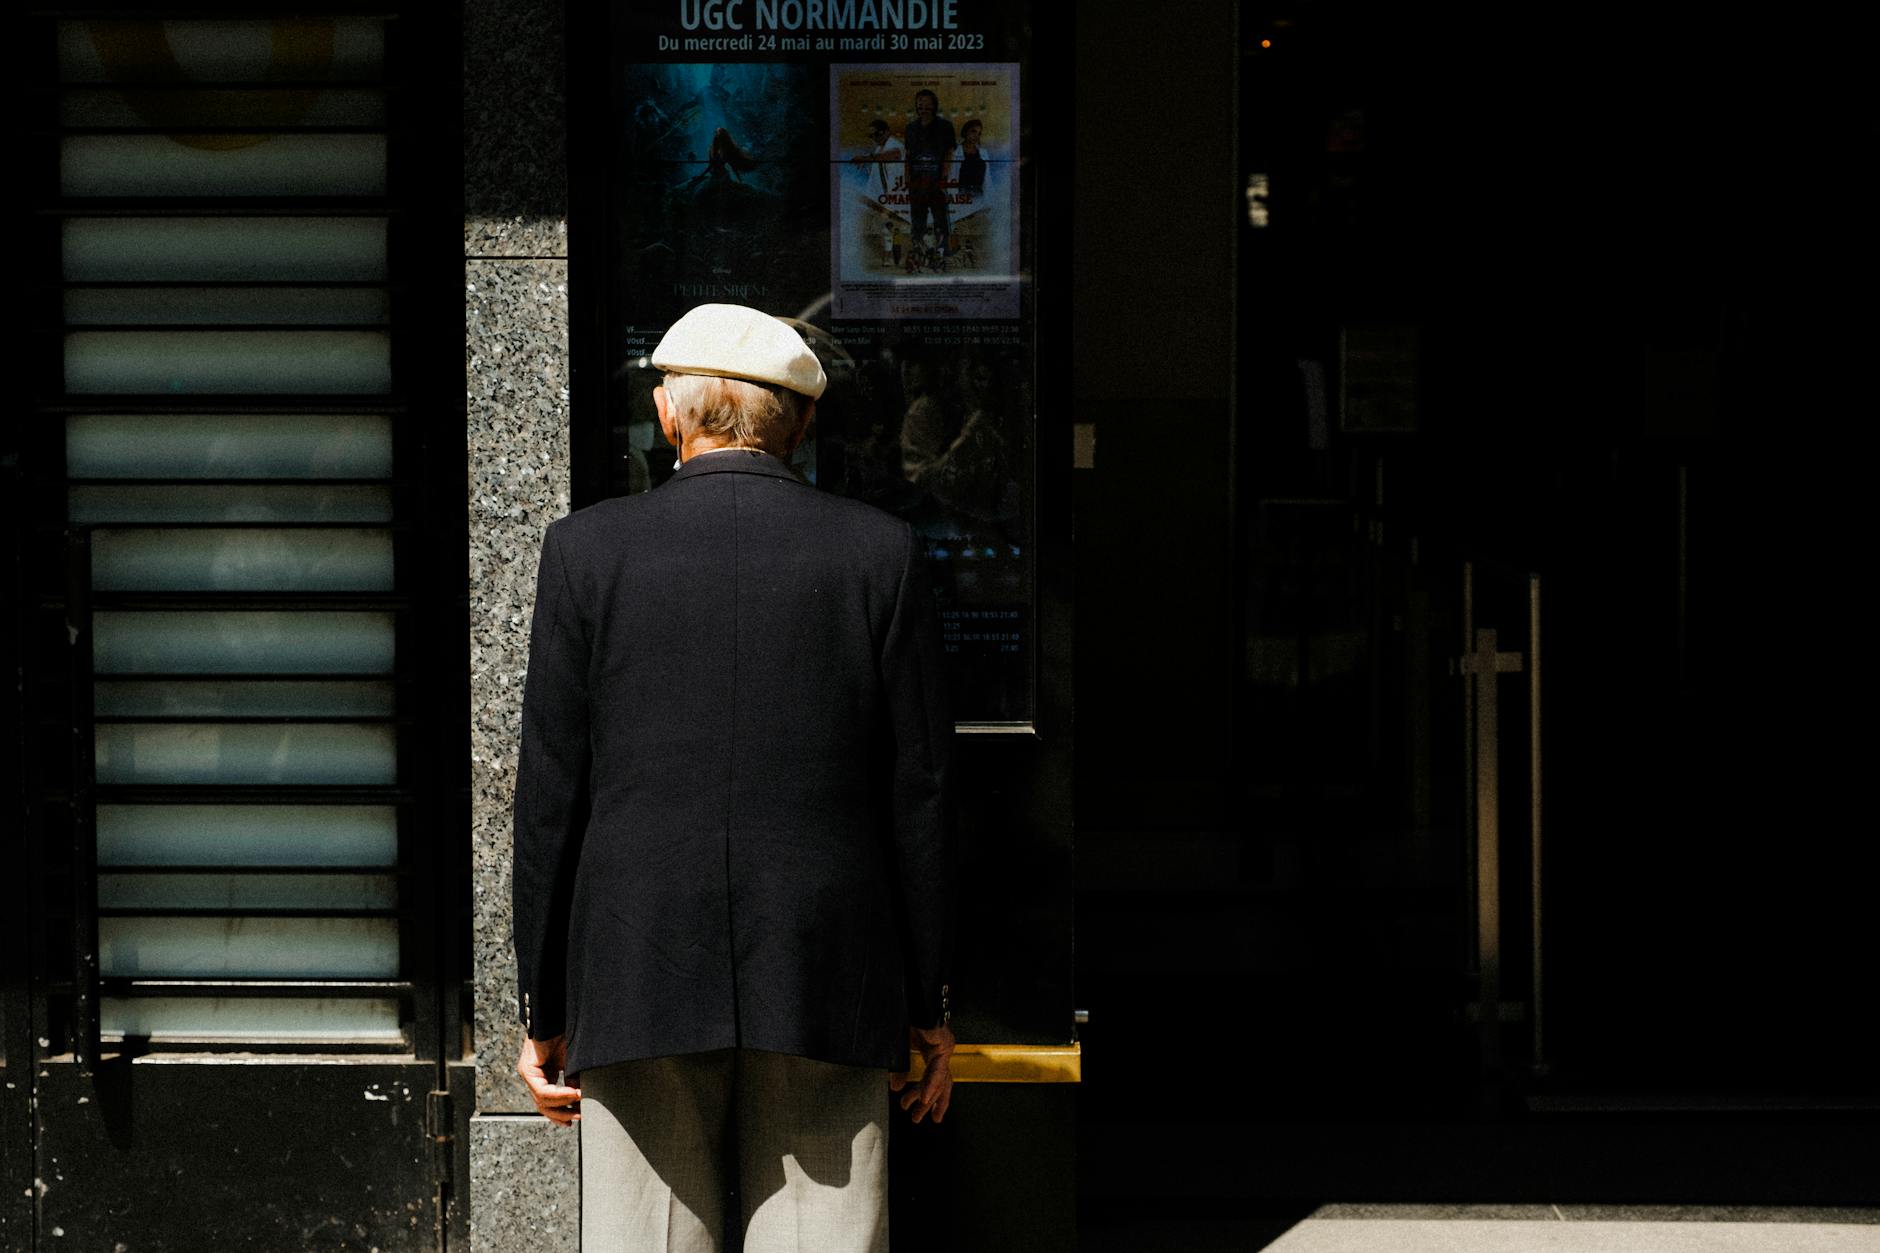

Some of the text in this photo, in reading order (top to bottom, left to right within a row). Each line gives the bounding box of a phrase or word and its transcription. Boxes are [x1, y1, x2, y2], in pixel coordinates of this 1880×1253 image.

[680, 0, 959, 31] UGC NORMANDIE
[659, 34, 985, 51] Du mercredi 24 mai au mardi 30 mai 2023
